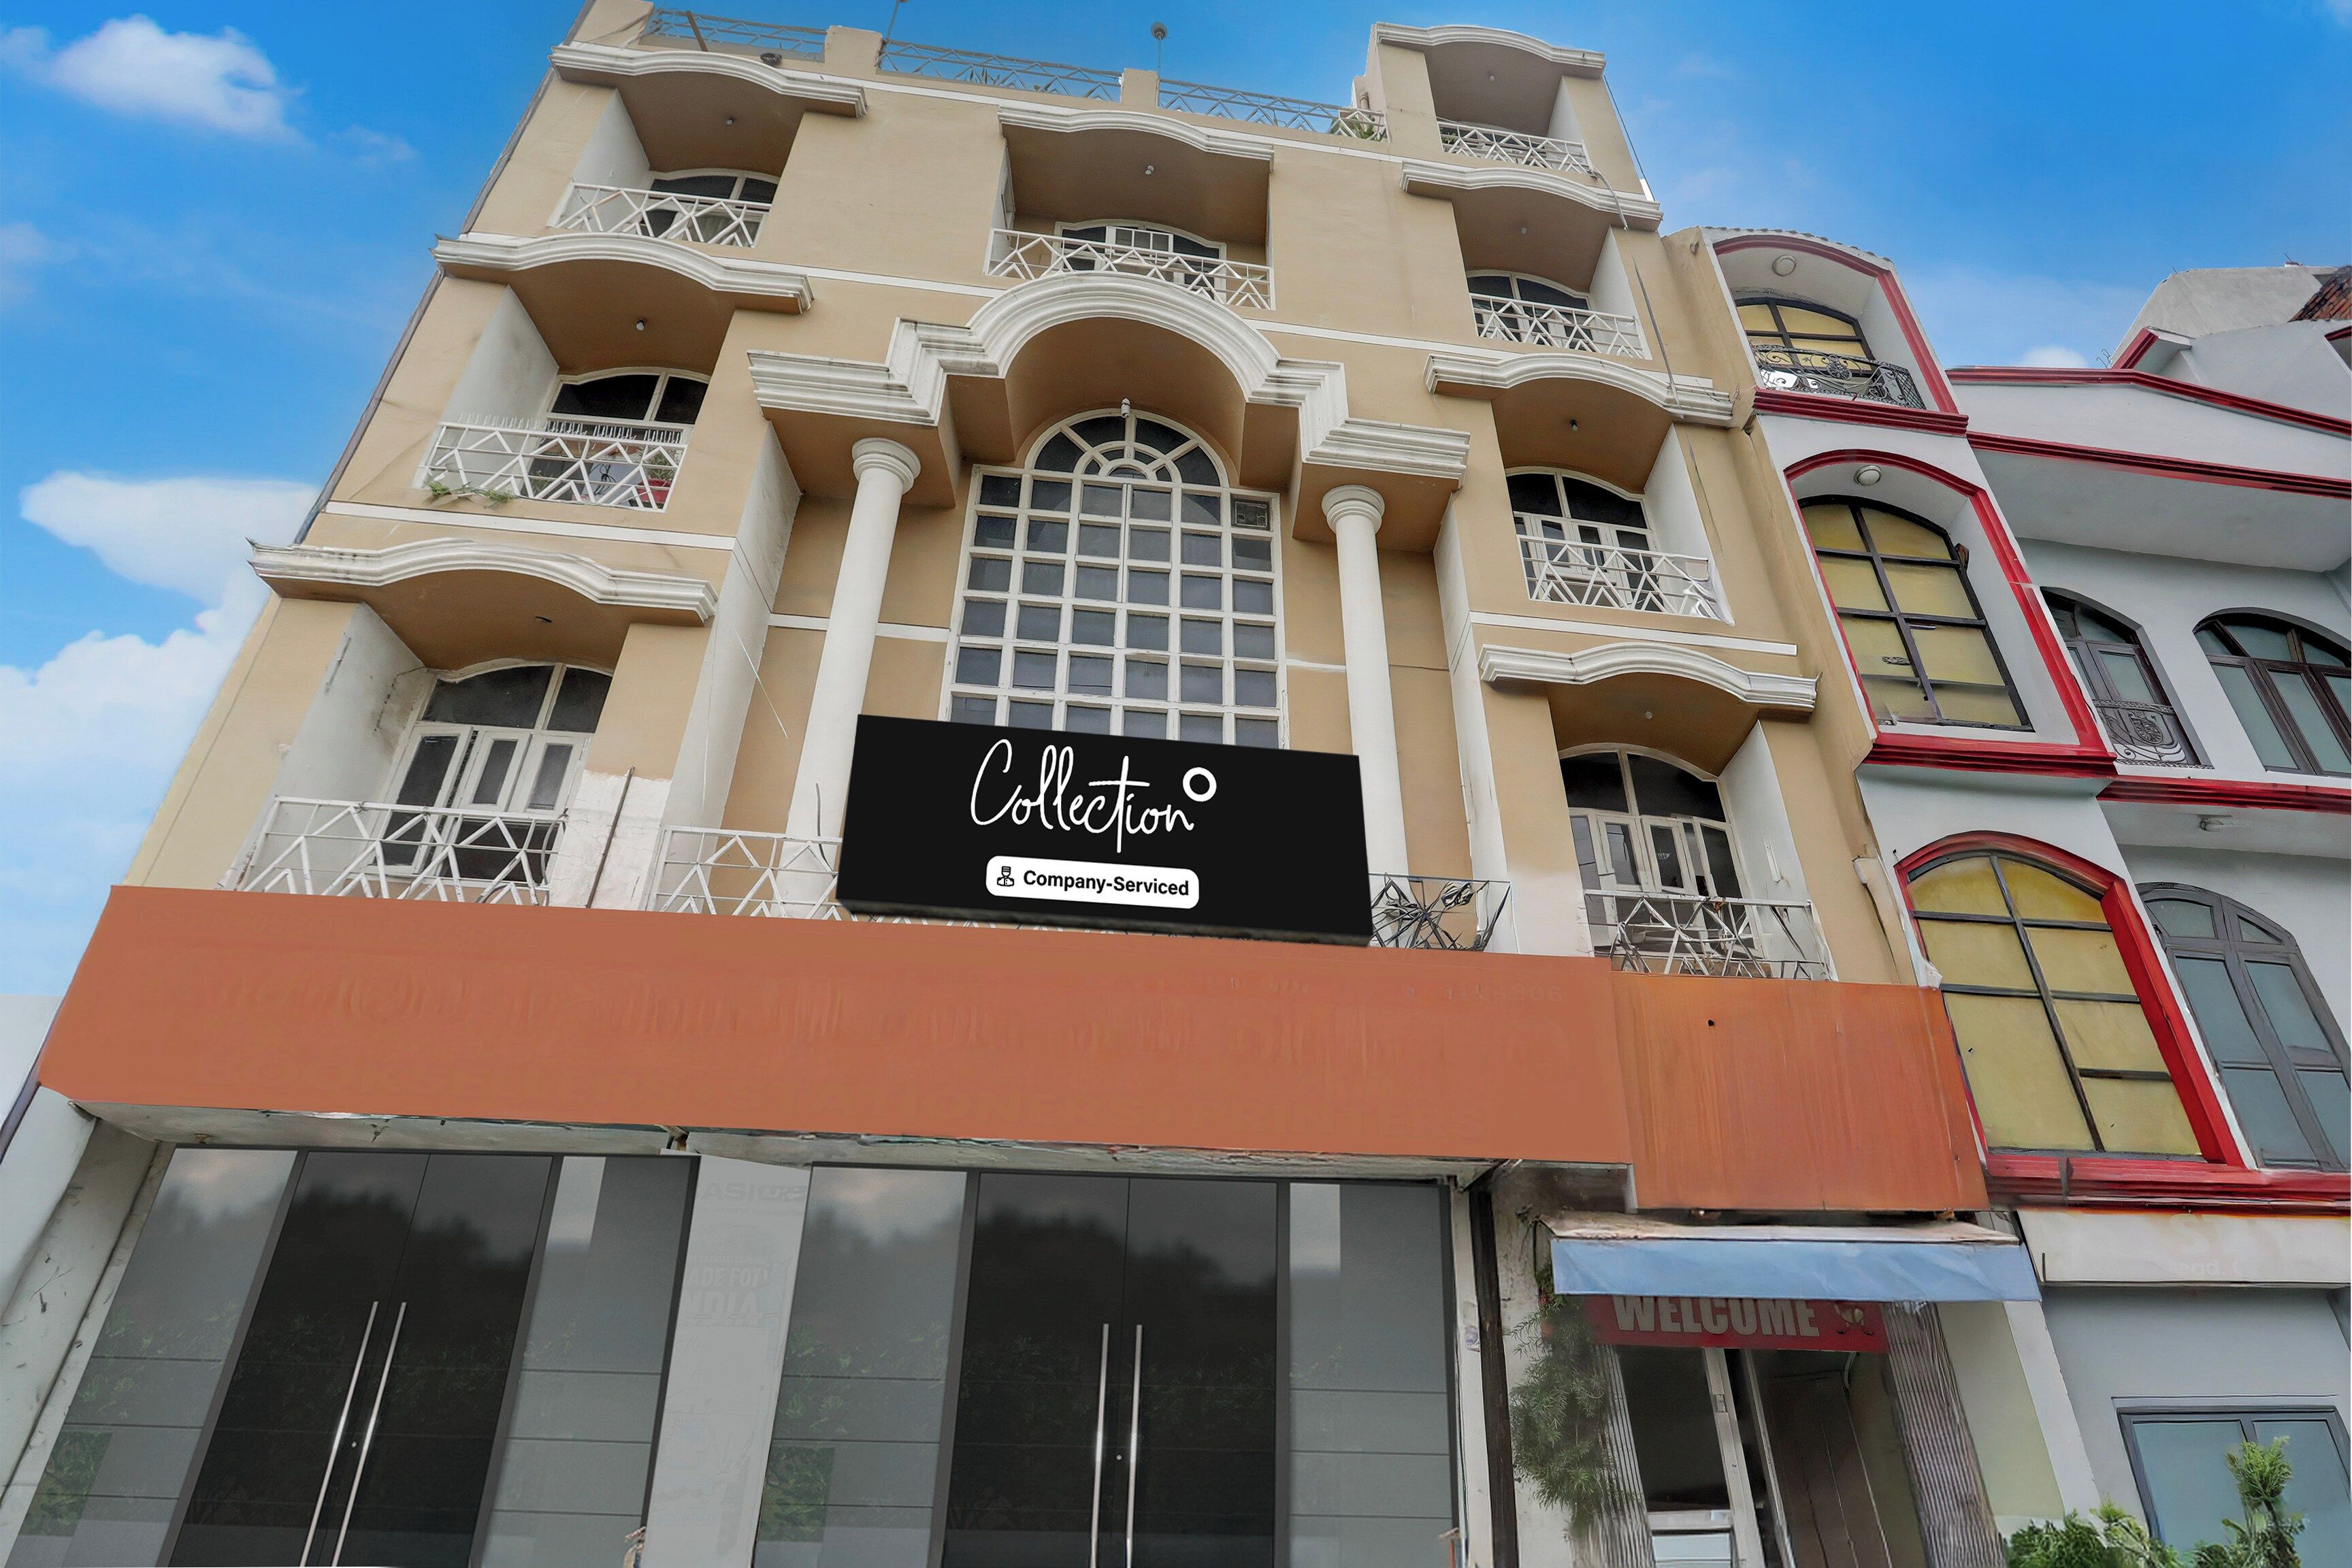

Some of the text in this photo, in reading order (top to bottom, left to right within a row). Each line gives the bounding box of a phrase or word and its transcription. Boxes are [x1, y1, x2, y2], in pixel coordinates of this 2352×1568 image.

[970, 739, 1195, 853] Collection
[1023, 869, 1190, 897] Company-Serviced
[1613, 1295, 1820, 1337] WELCOME
